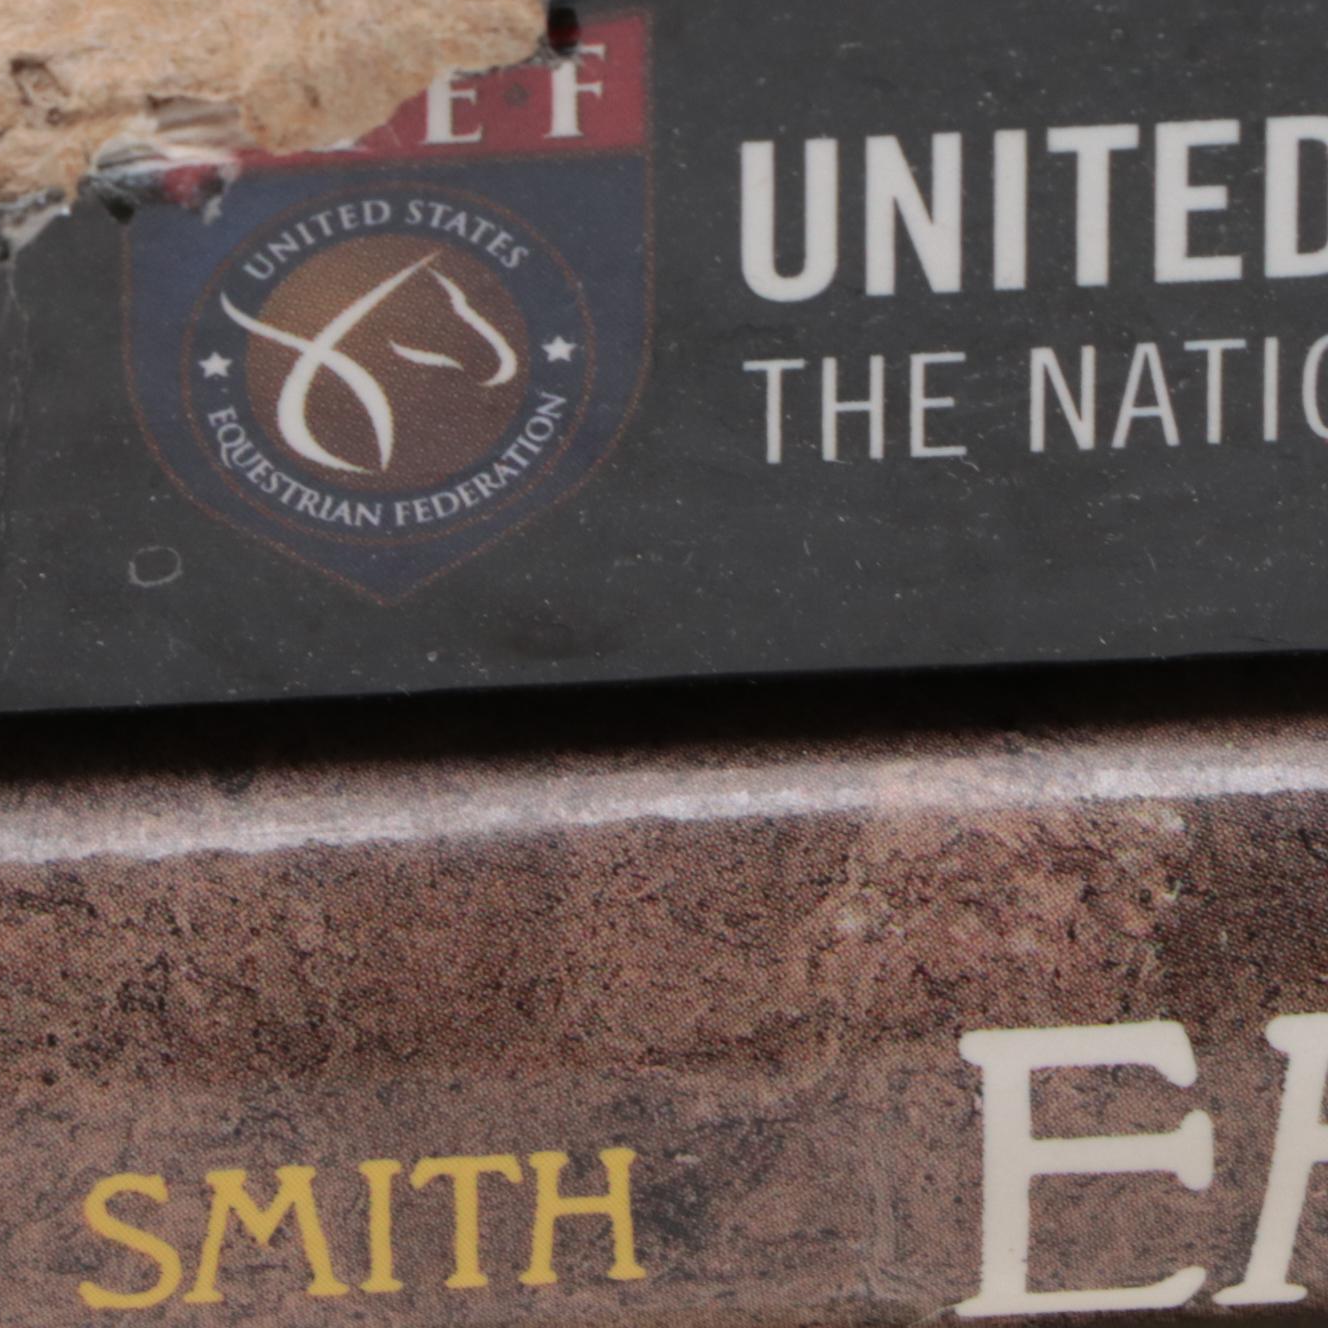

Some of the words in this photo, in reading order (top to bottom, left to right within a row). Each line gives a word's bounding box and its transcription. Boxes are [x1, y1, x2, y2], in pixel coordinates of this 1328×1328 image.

[244, 197, 392, 281] UNITED
[406, 198, 530, 271] STATES
[740, 114, 1328, 303] UNITED
[207, 406, 384, 528] EQUESTRIAN
[396, 390, 568, 527] FEDERATION
[742, 351, 967, 465] THE
[78, 1146, 647, 1310] SMITH
